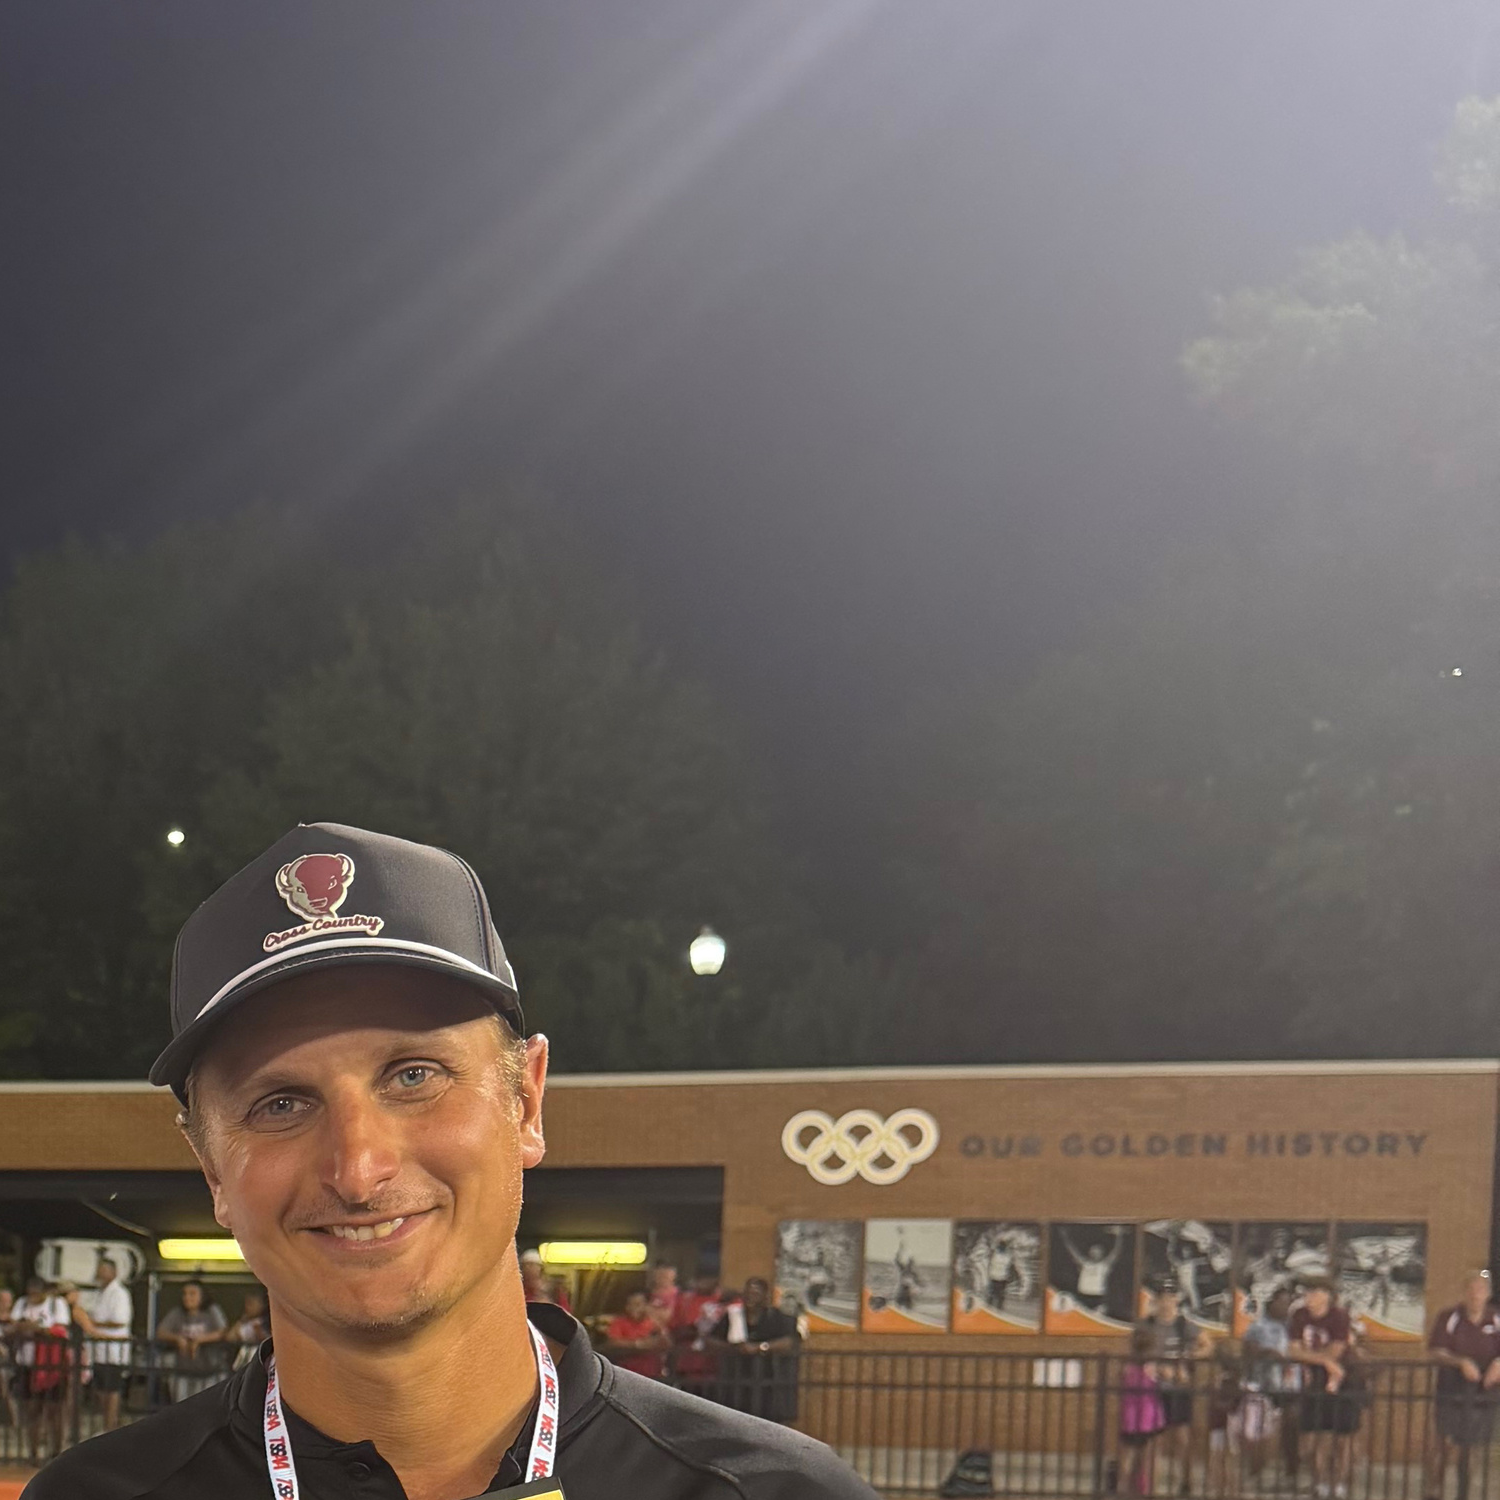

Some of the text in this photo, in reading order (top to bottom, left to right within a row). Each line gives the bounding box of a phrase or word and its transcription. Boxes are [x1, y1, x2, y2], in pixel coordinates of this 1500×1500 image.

[265, 915, 381, 948] Cross Country
[959, 1130, 1428, 1159] OUR GOLDEN HISTORY
